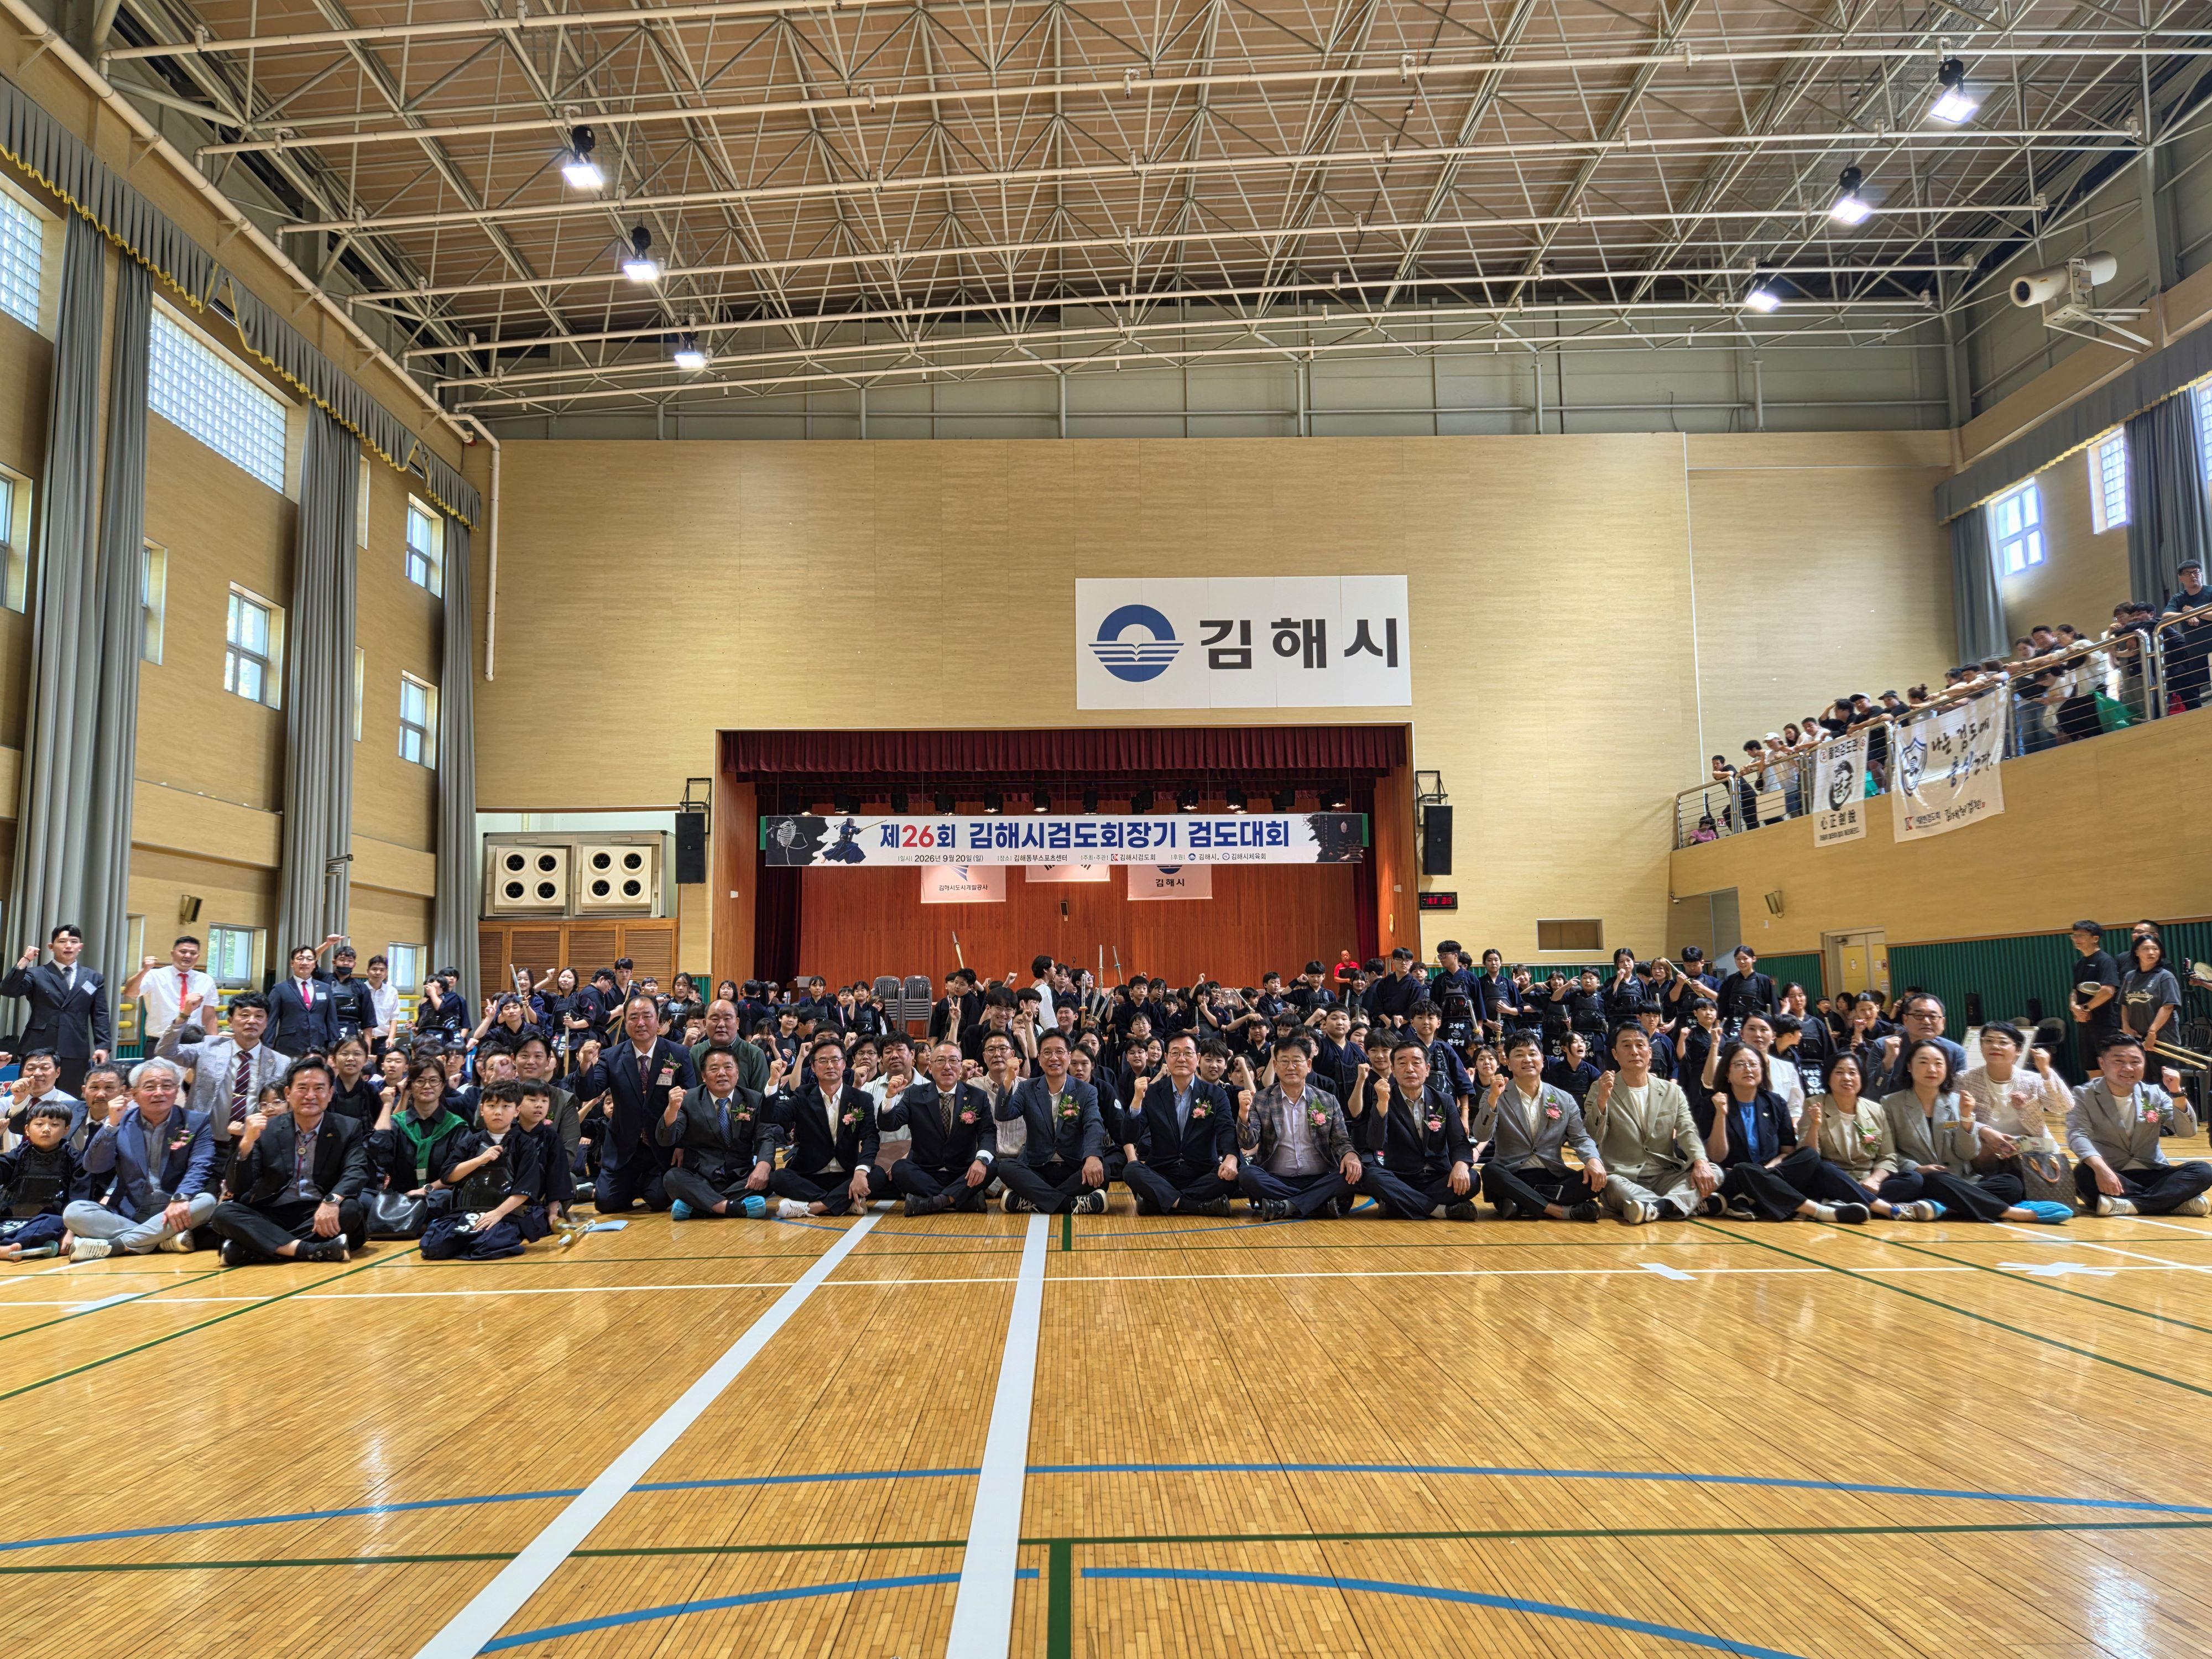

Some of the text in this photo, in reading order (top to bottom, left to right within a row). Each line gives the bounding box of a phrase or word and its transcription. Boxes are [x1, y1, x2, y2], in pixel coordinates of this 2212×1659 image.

[1199, 618, 1398, 670] 김해시
[880, 821, 1289, 848] 제26회 김해시검도회장기 검도대회
[1155, 878, 1185, 887] 김해시
